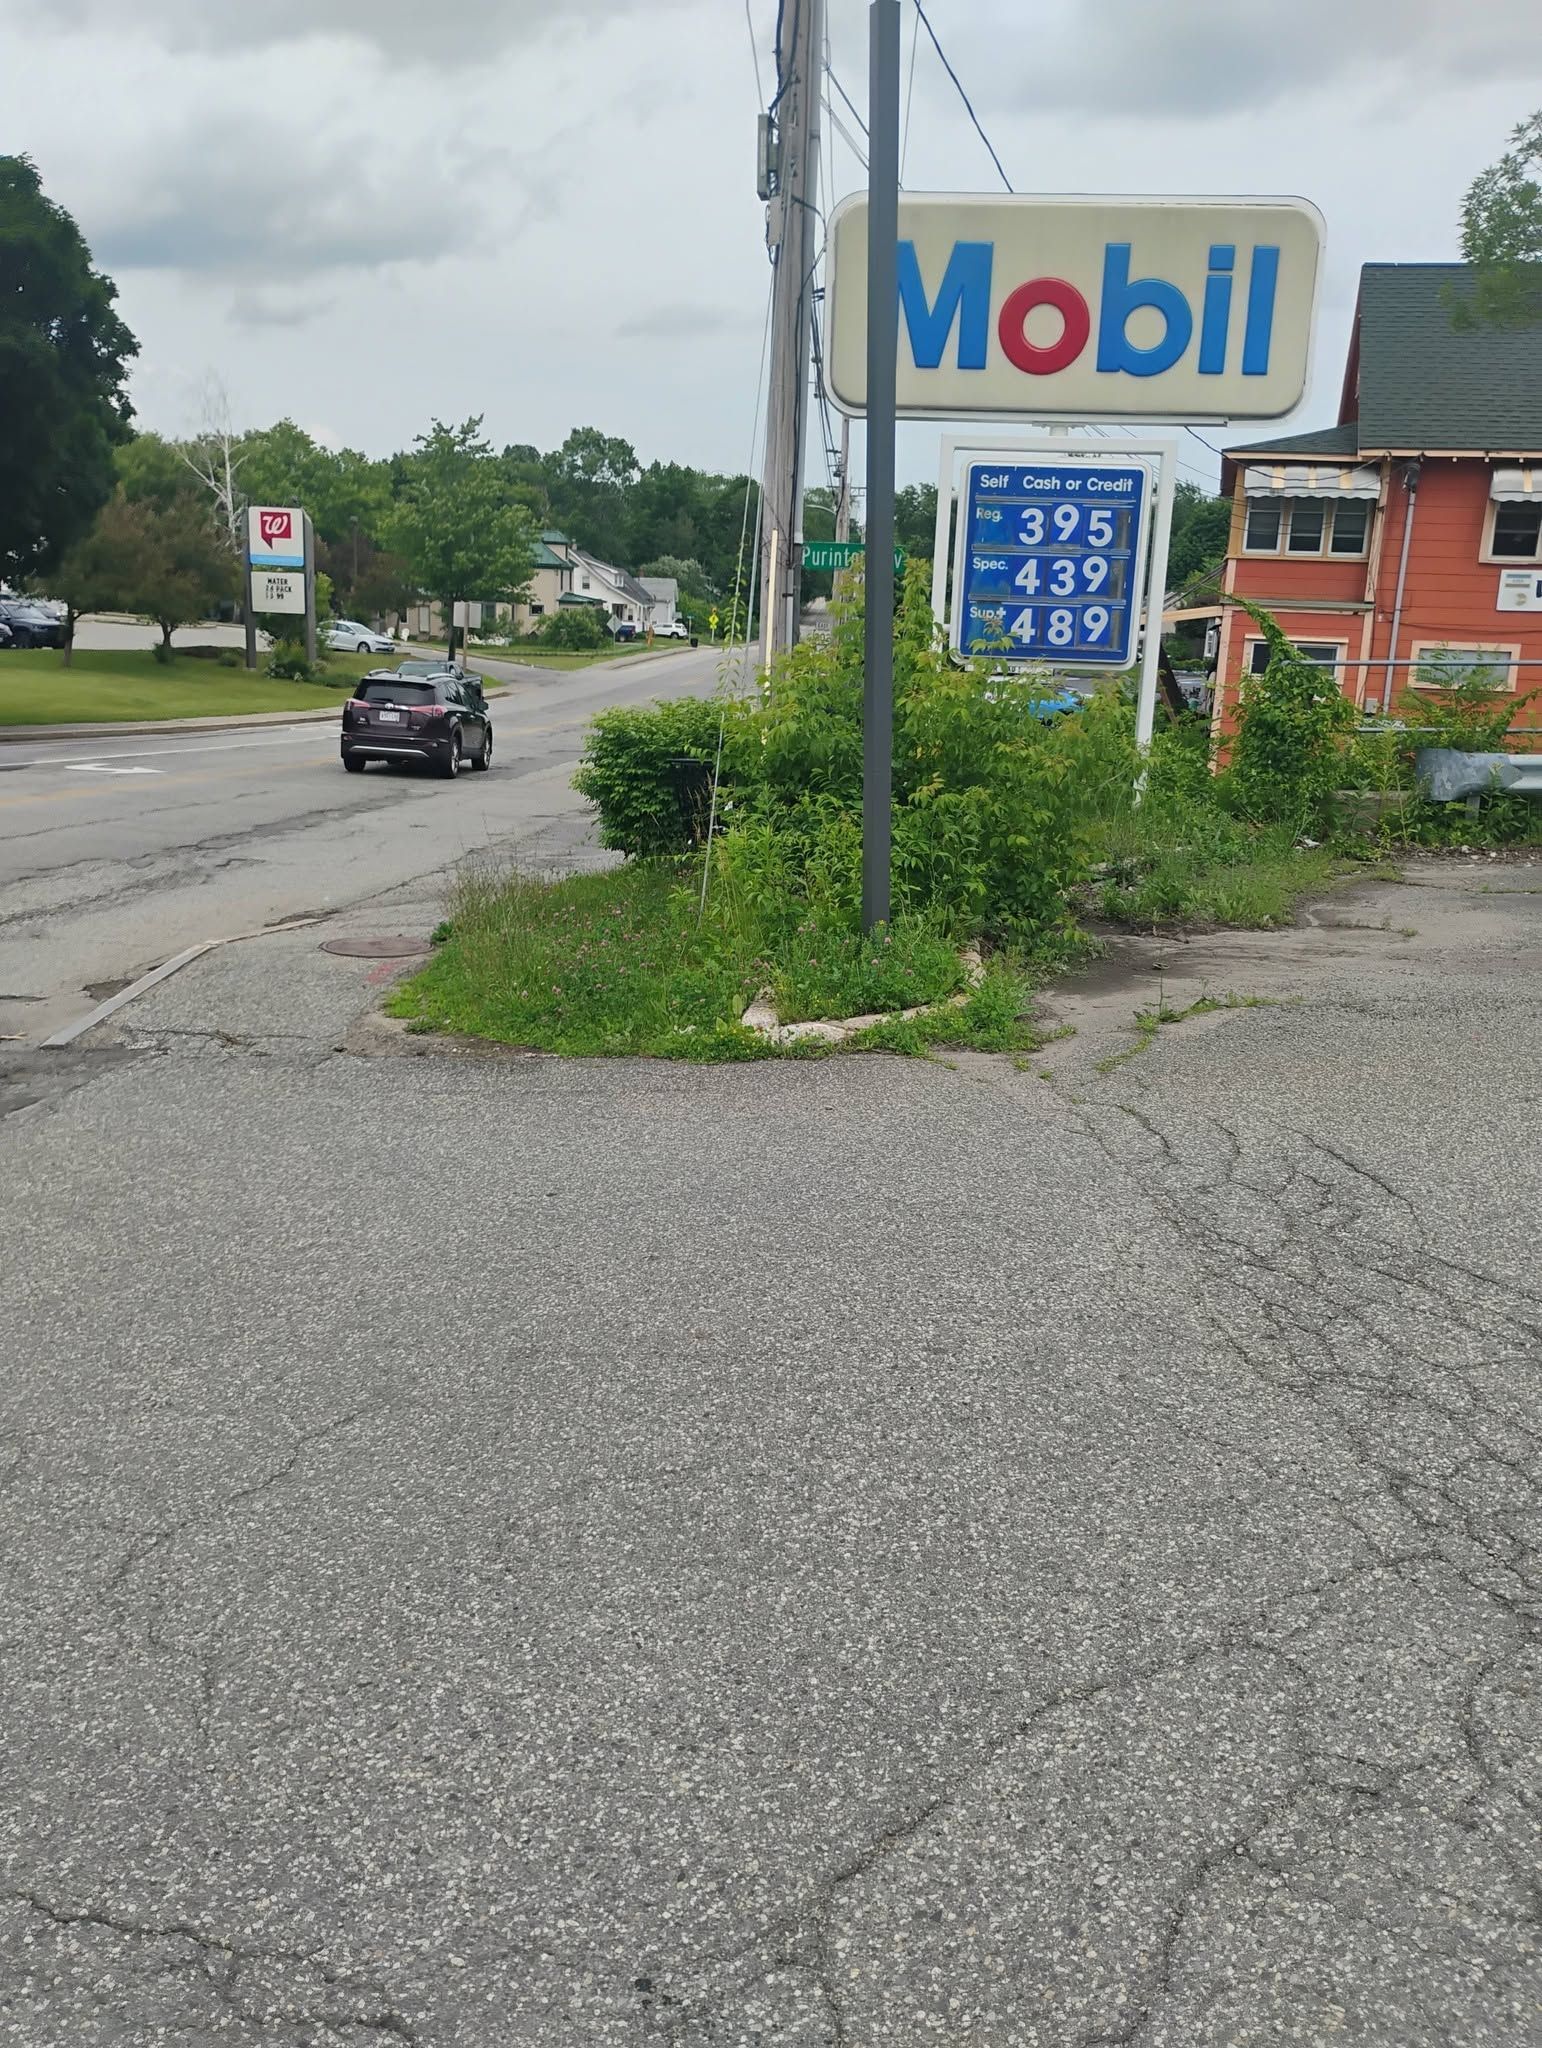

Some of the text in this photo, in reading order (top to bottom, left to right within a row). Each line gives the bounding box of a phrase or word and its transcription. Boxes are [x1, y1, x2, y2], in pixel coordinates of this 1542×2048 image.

[895, 239, 1281, 378] Mobil
[979, 473, 1134, 493] Self Cash or Credit
[975, 503, 1114, 548] Reg. 395
[801, 545, 866, 568] Purinto
[972, 555, 1109, 597] Spec. 439
[1010, 605, 1110, 646] 489
